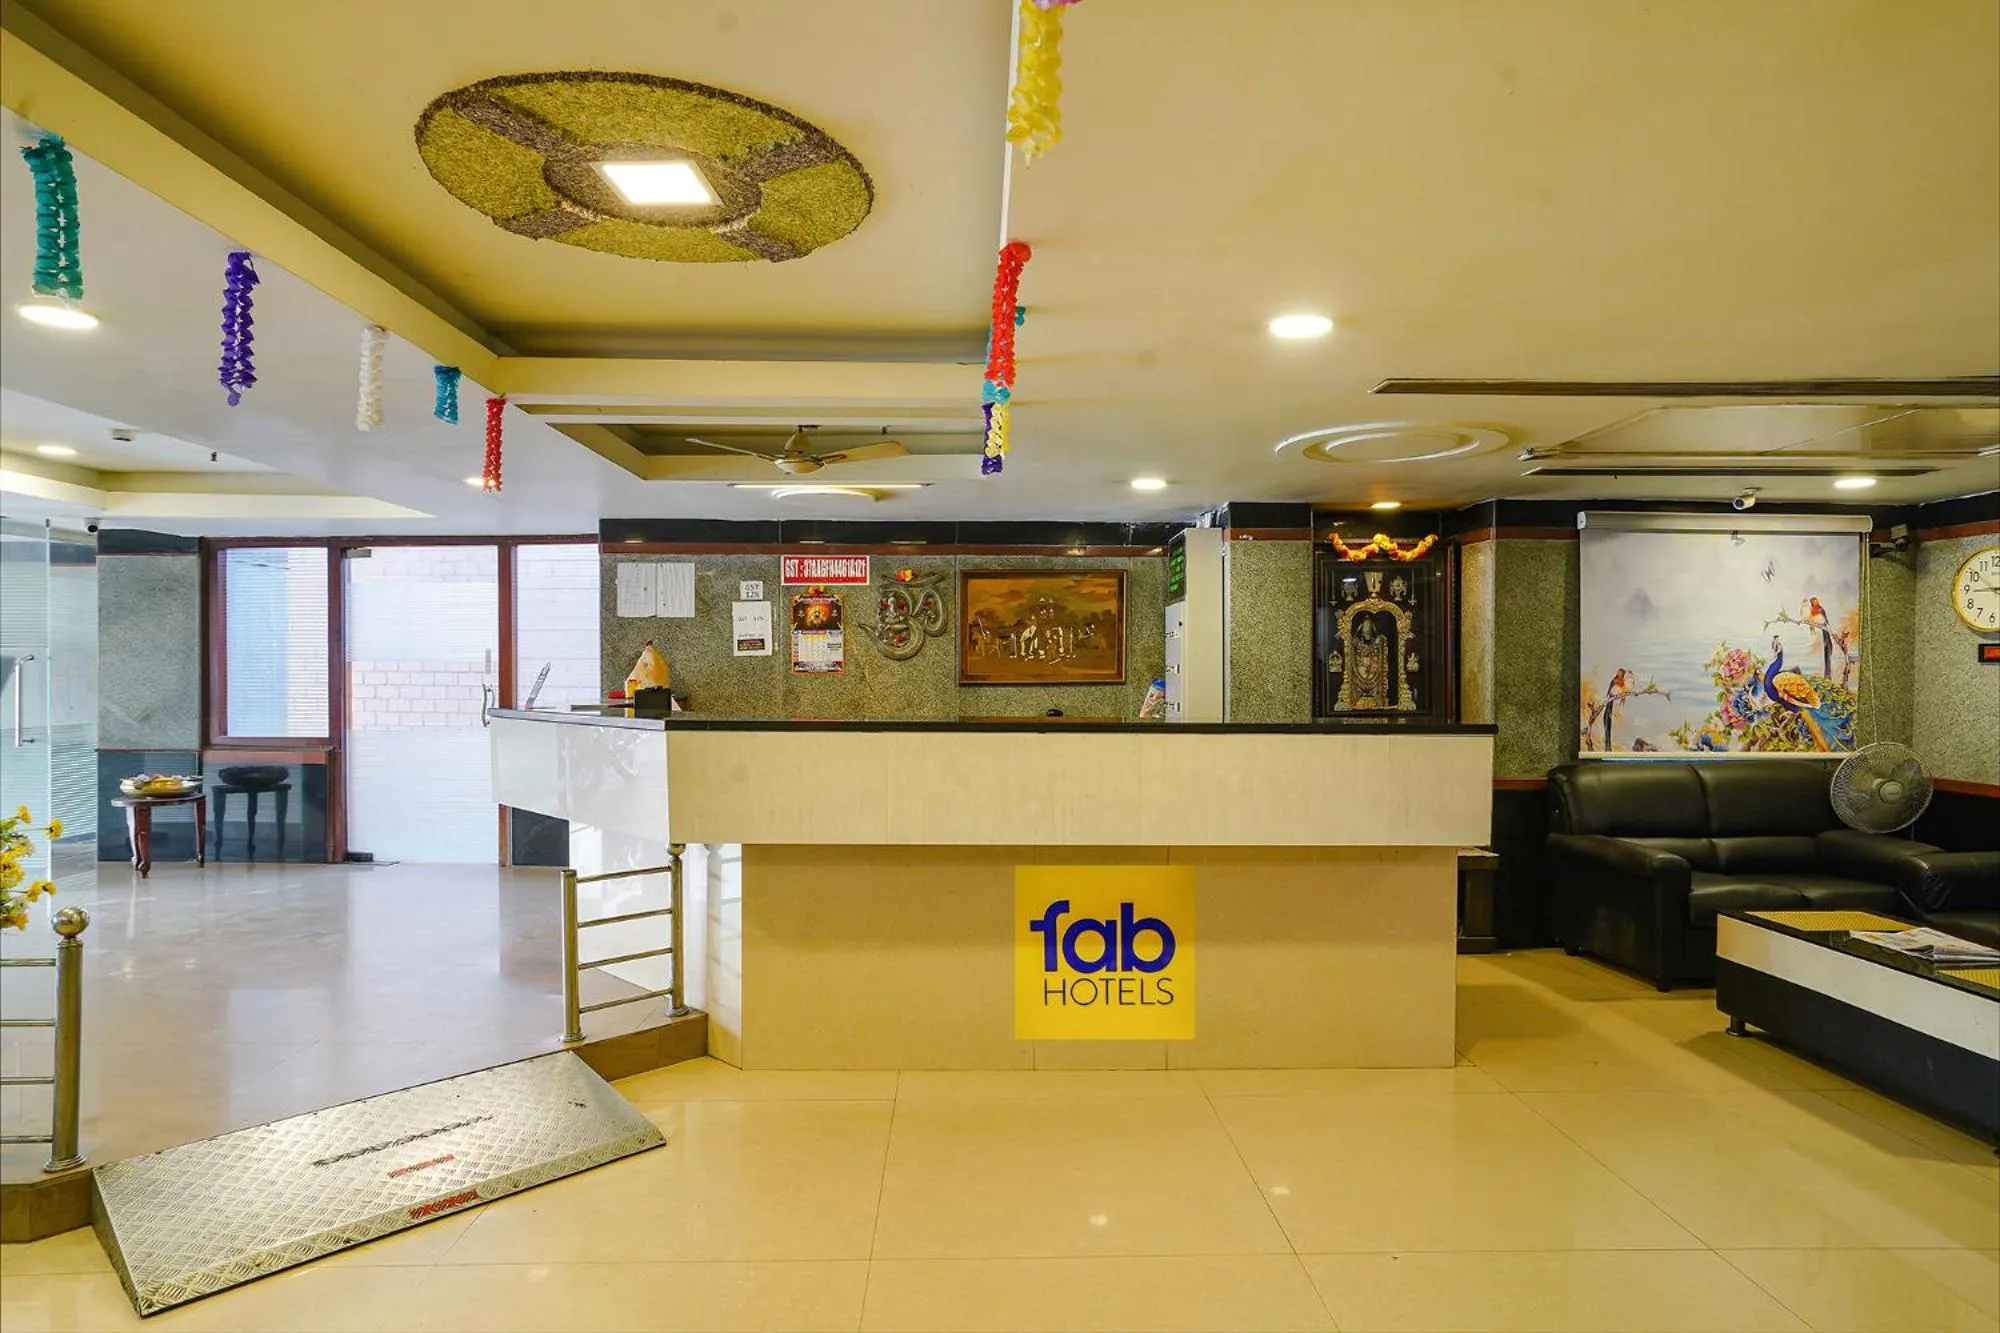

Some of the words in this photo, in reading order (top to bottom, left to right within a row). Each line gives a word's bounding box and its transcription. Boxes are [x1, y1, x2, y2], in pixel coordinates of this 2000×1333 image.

[785, 559, 799, 578] GST
[1980, 561, 1987, 572] 11
[1969, 571, 1980, 582] 10
[1964, 584, 1970, 595] 9
[1967, 598, 1974, 609] 8
[1976, 607, 1983, 618] 7
[1989, 612, 1995, 623] 6
[1029, 899, 1176, 974] fab
[1044, 977, 1174, 1006] HOTELS
